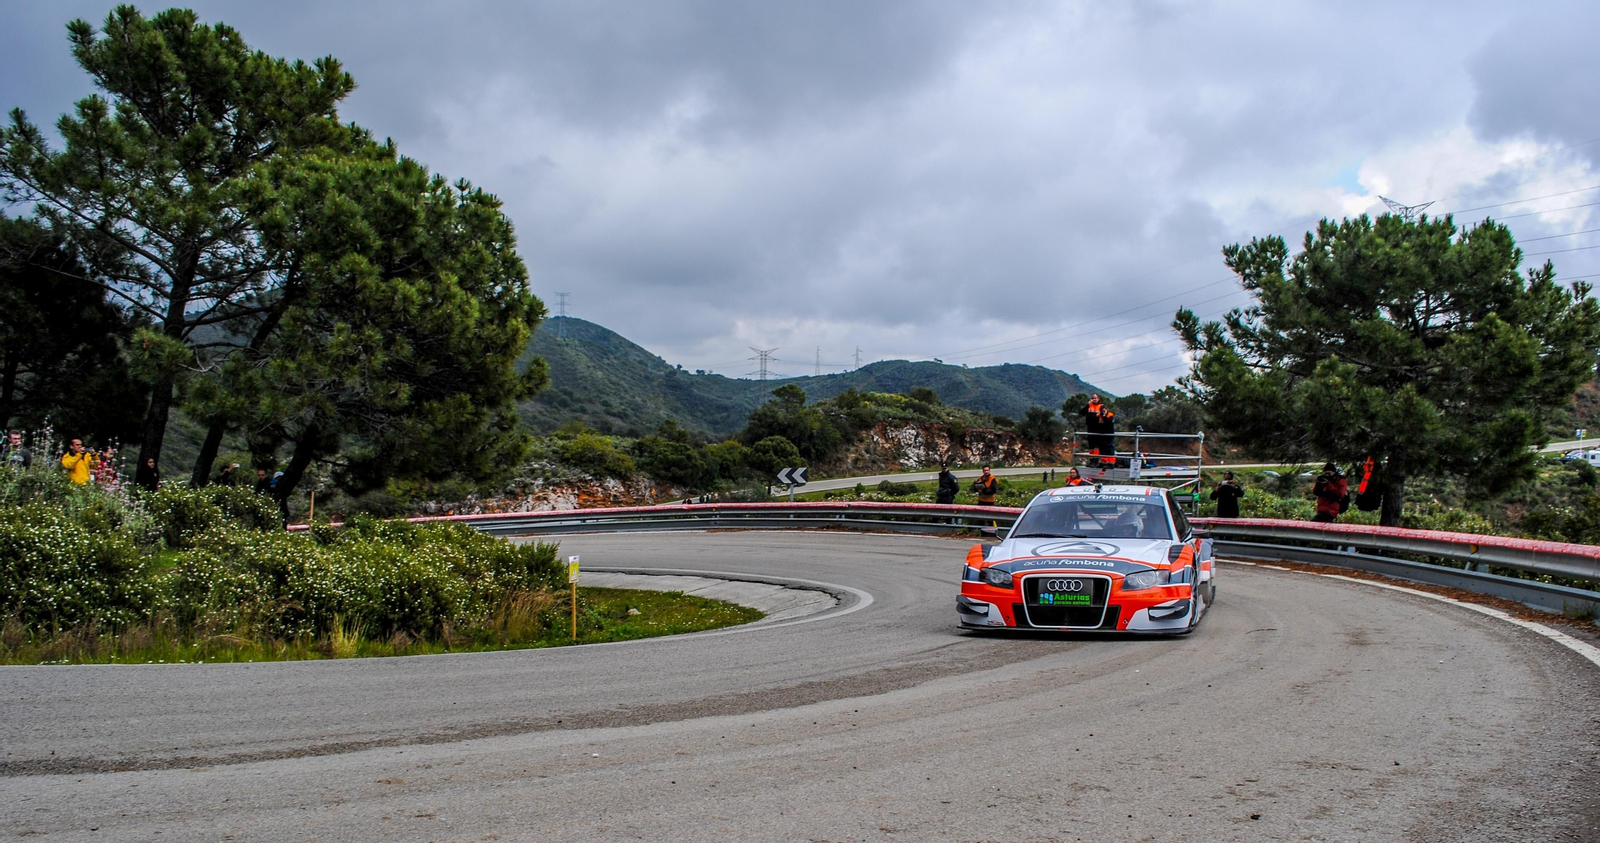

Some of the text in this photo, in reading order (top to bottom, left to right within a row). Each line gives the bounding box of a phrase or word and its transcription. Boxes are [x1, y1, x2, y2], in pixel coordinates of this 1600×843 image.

[1096, 494, 1146, 502] fombona
[1058, 559, 1115, 567] fombona
[1054, 592, 1091, 601] Asturias
